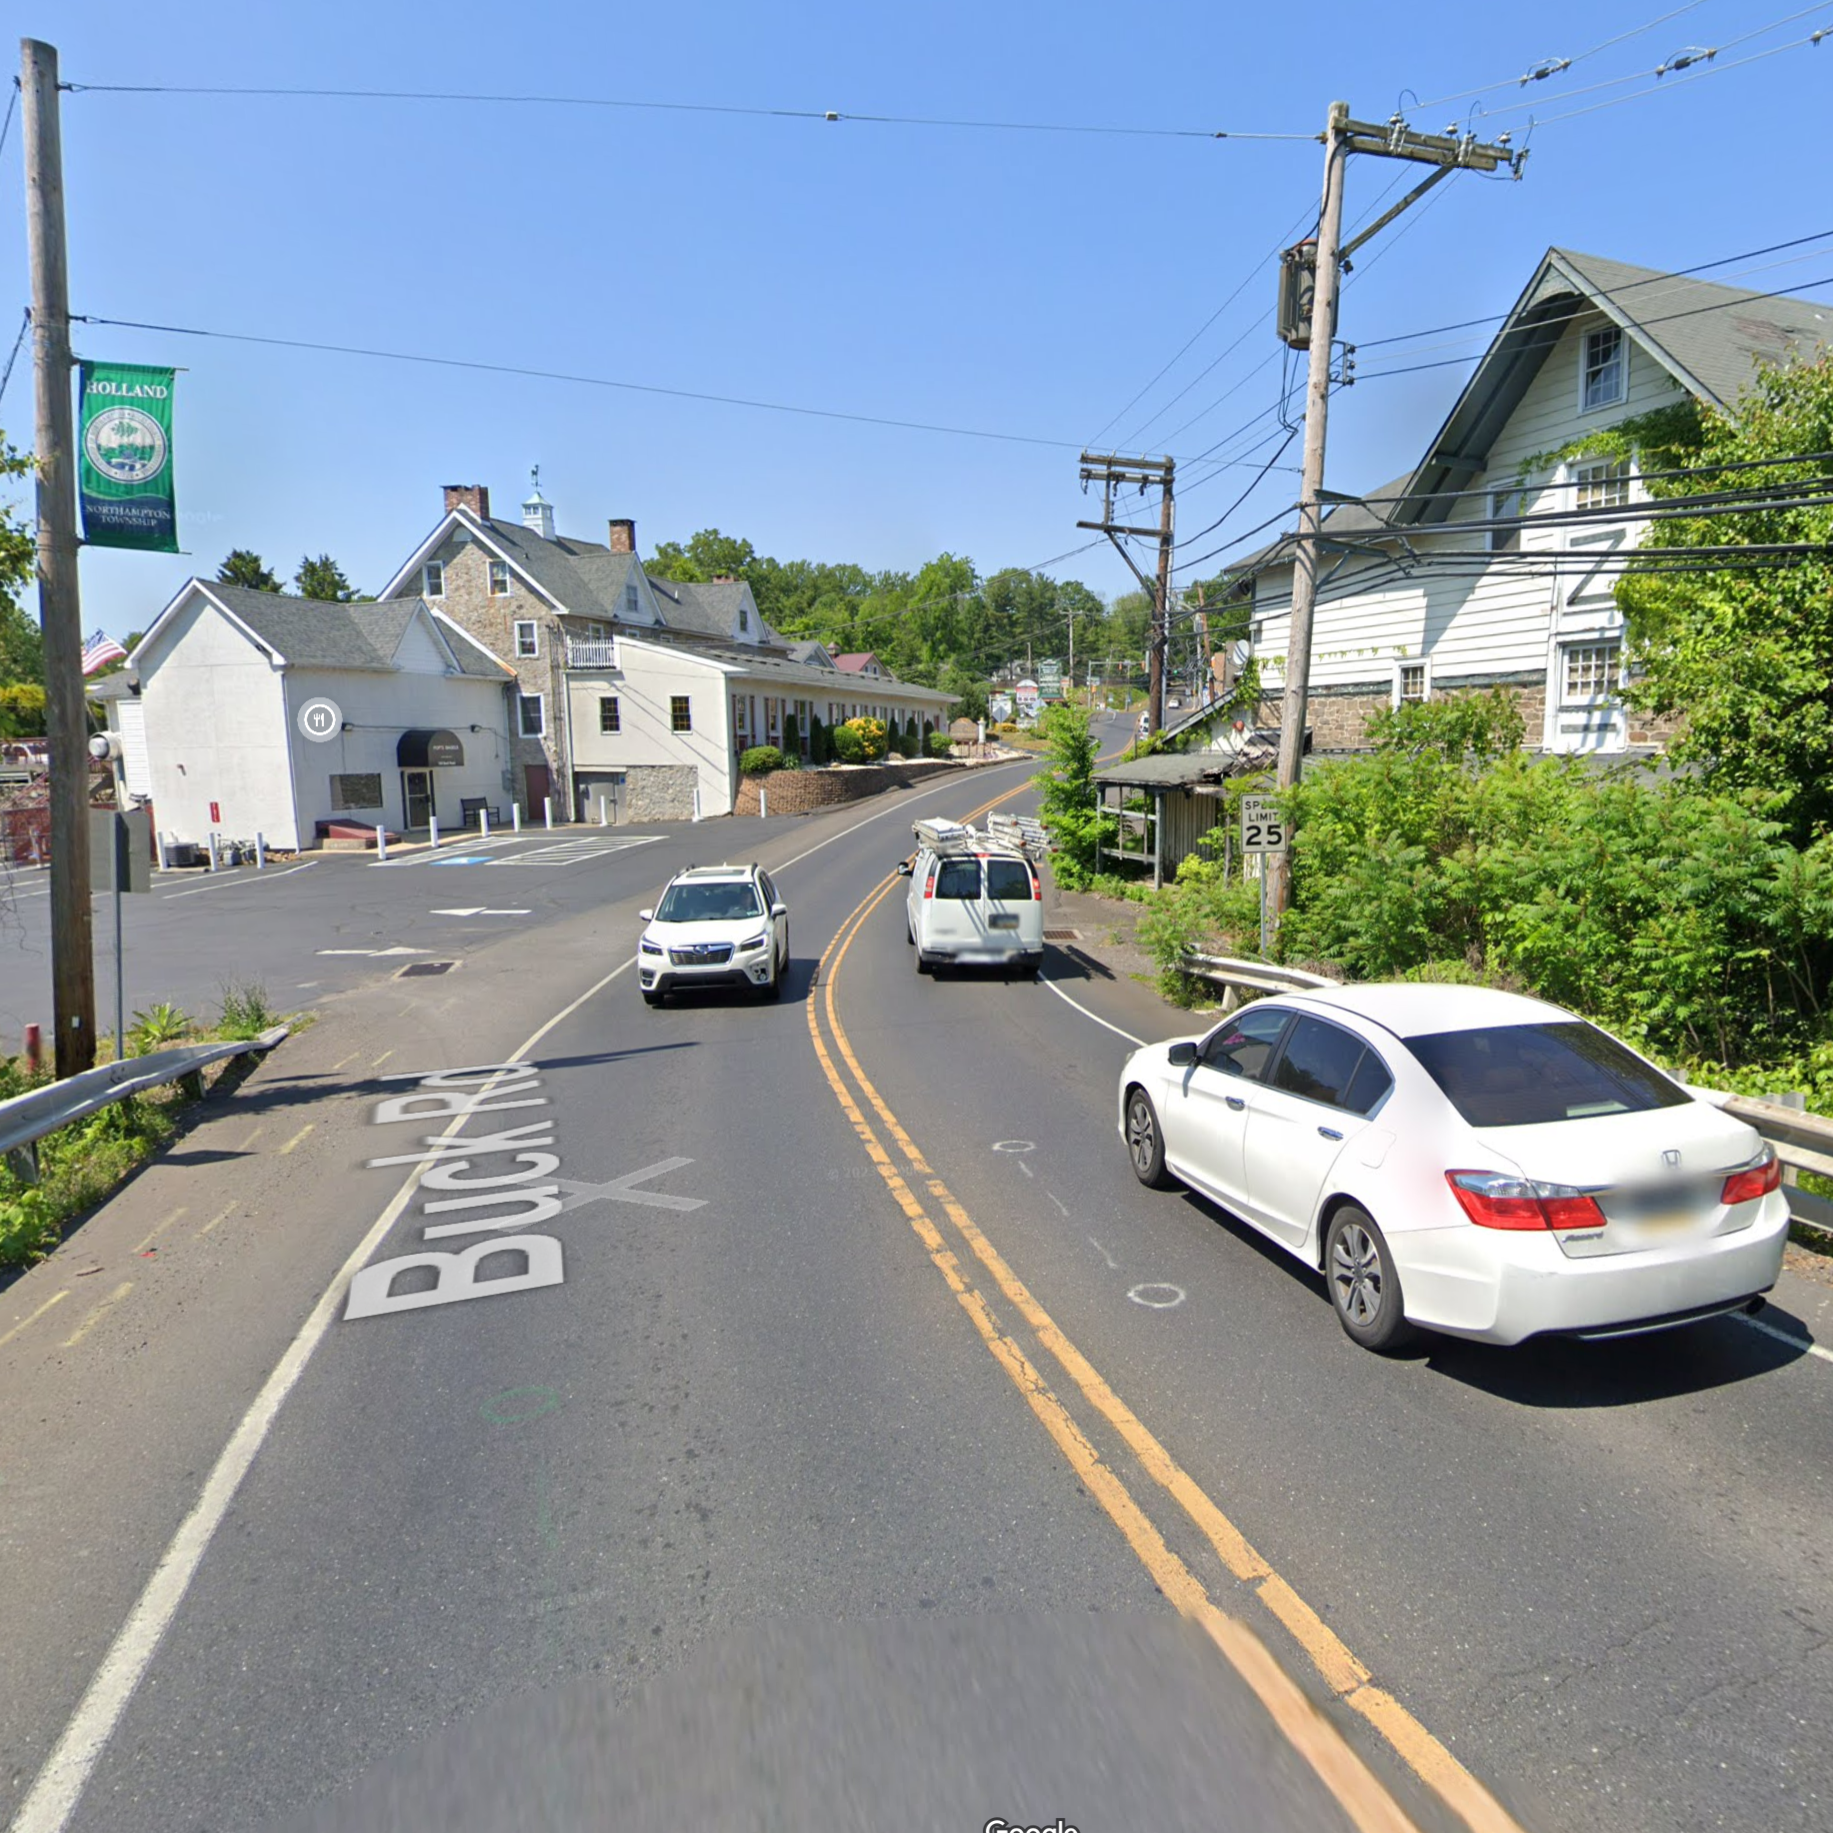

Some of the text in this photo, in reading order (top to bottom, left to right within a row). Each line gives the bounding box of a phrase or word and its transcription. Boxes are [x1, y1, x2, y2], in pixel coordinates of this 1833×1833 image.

[87, 381, 168, 399] HOLLAND
[86, 505, 171, 519] NORTHAMPTON
[101, 515, 157, 527] TOWNSHIP
[1248, 812, 1279, 822] LIMIT
[1246, 825, 1282, 846] 25
